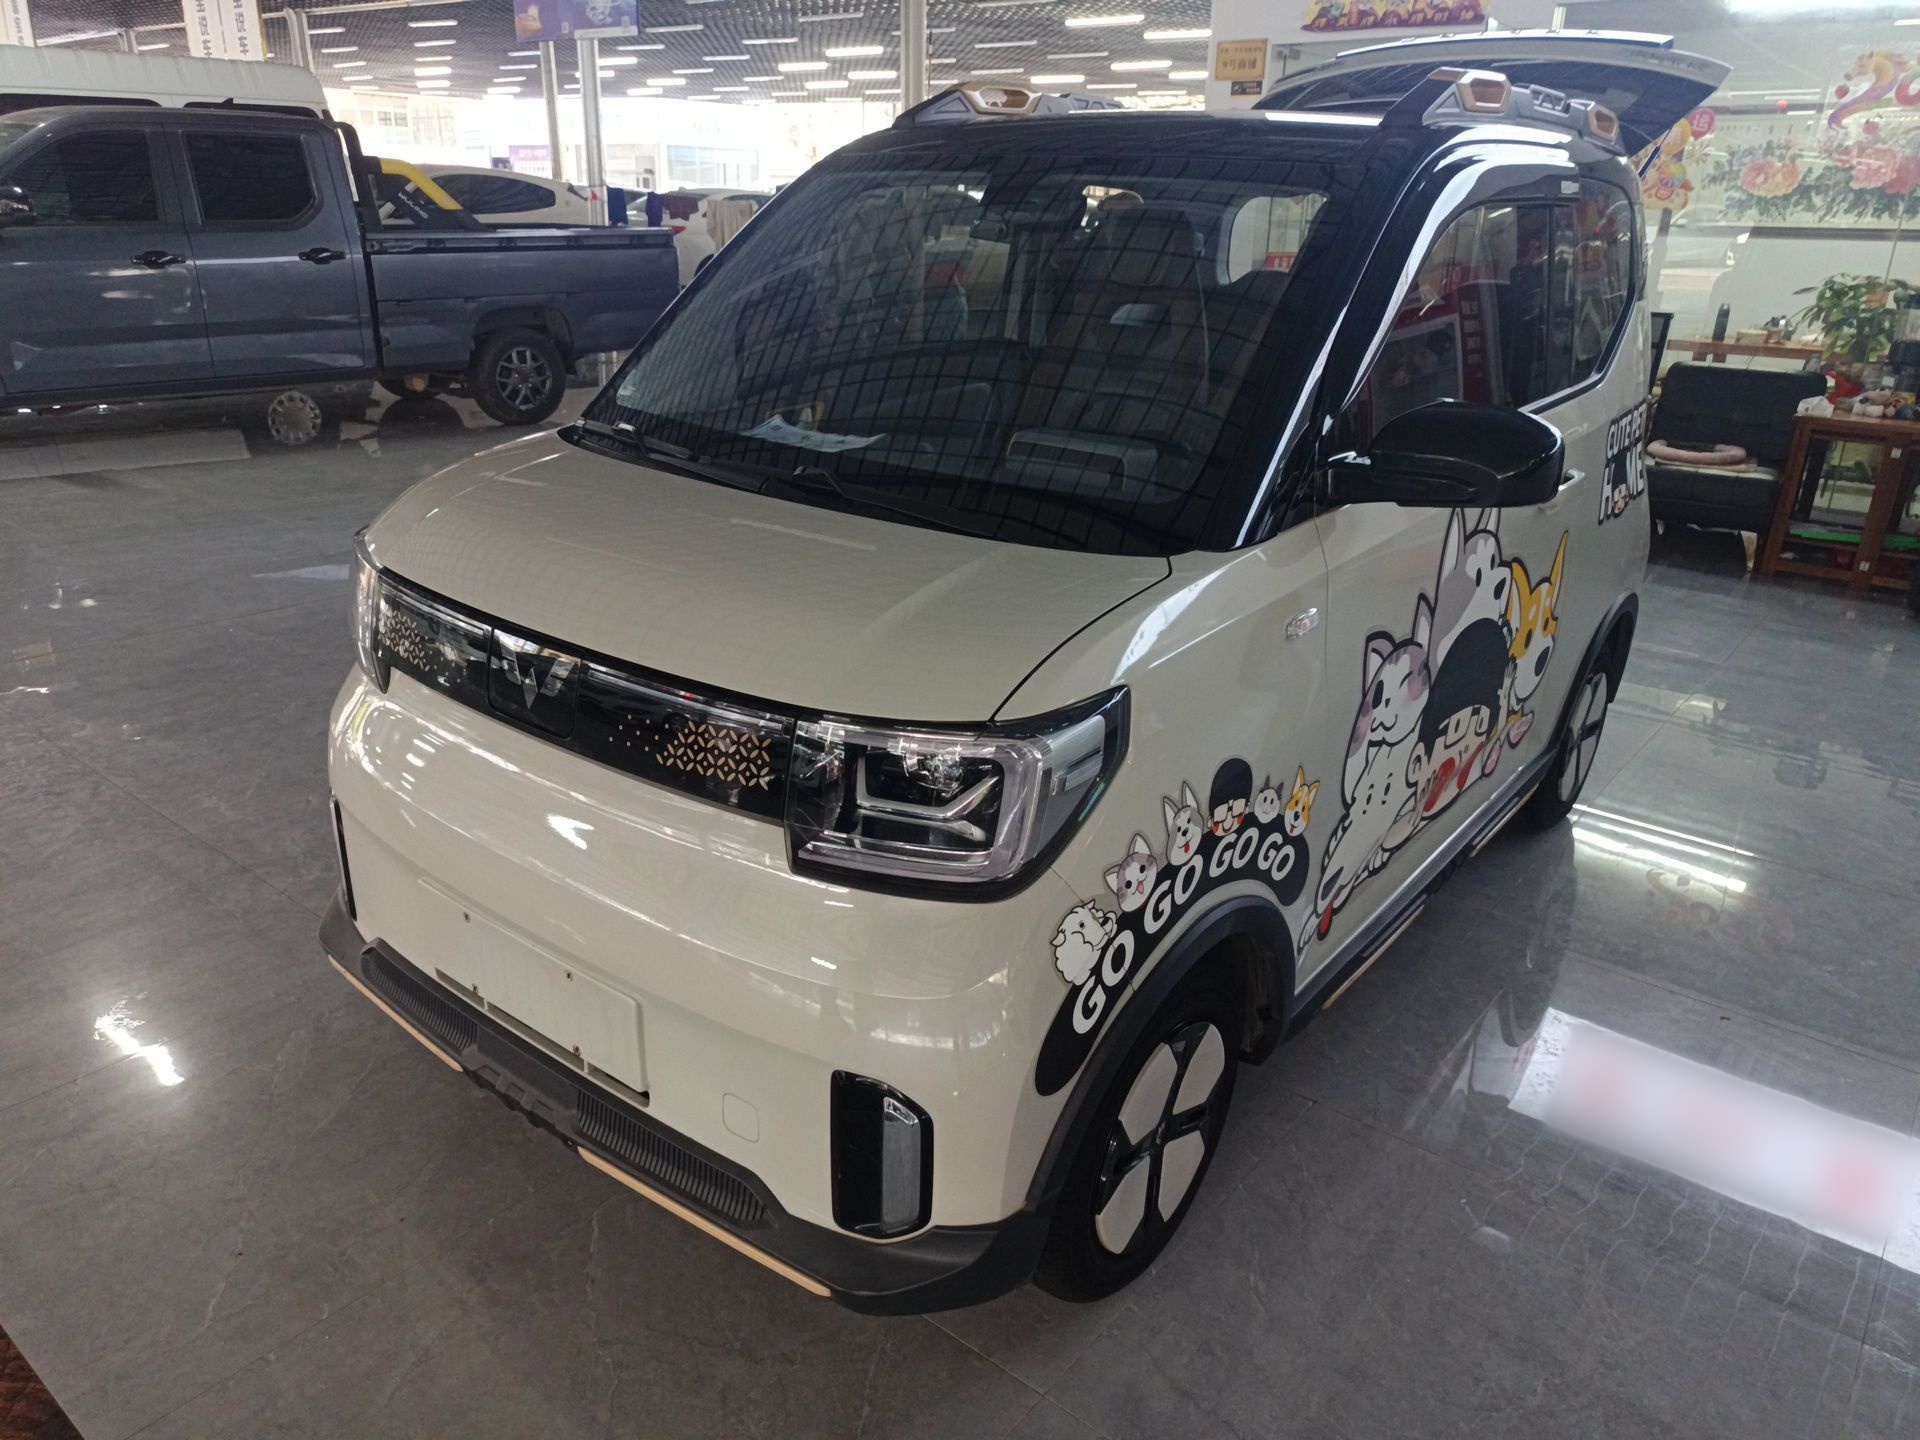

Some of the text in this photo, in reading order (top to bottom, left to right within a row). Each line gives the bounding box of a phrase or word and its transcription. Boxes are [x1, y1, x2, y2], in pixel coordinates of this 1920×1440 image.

[1607, 414, 1632, 459] CUTE
[1073, 828, 1296, 1034] GO GO GO GO
